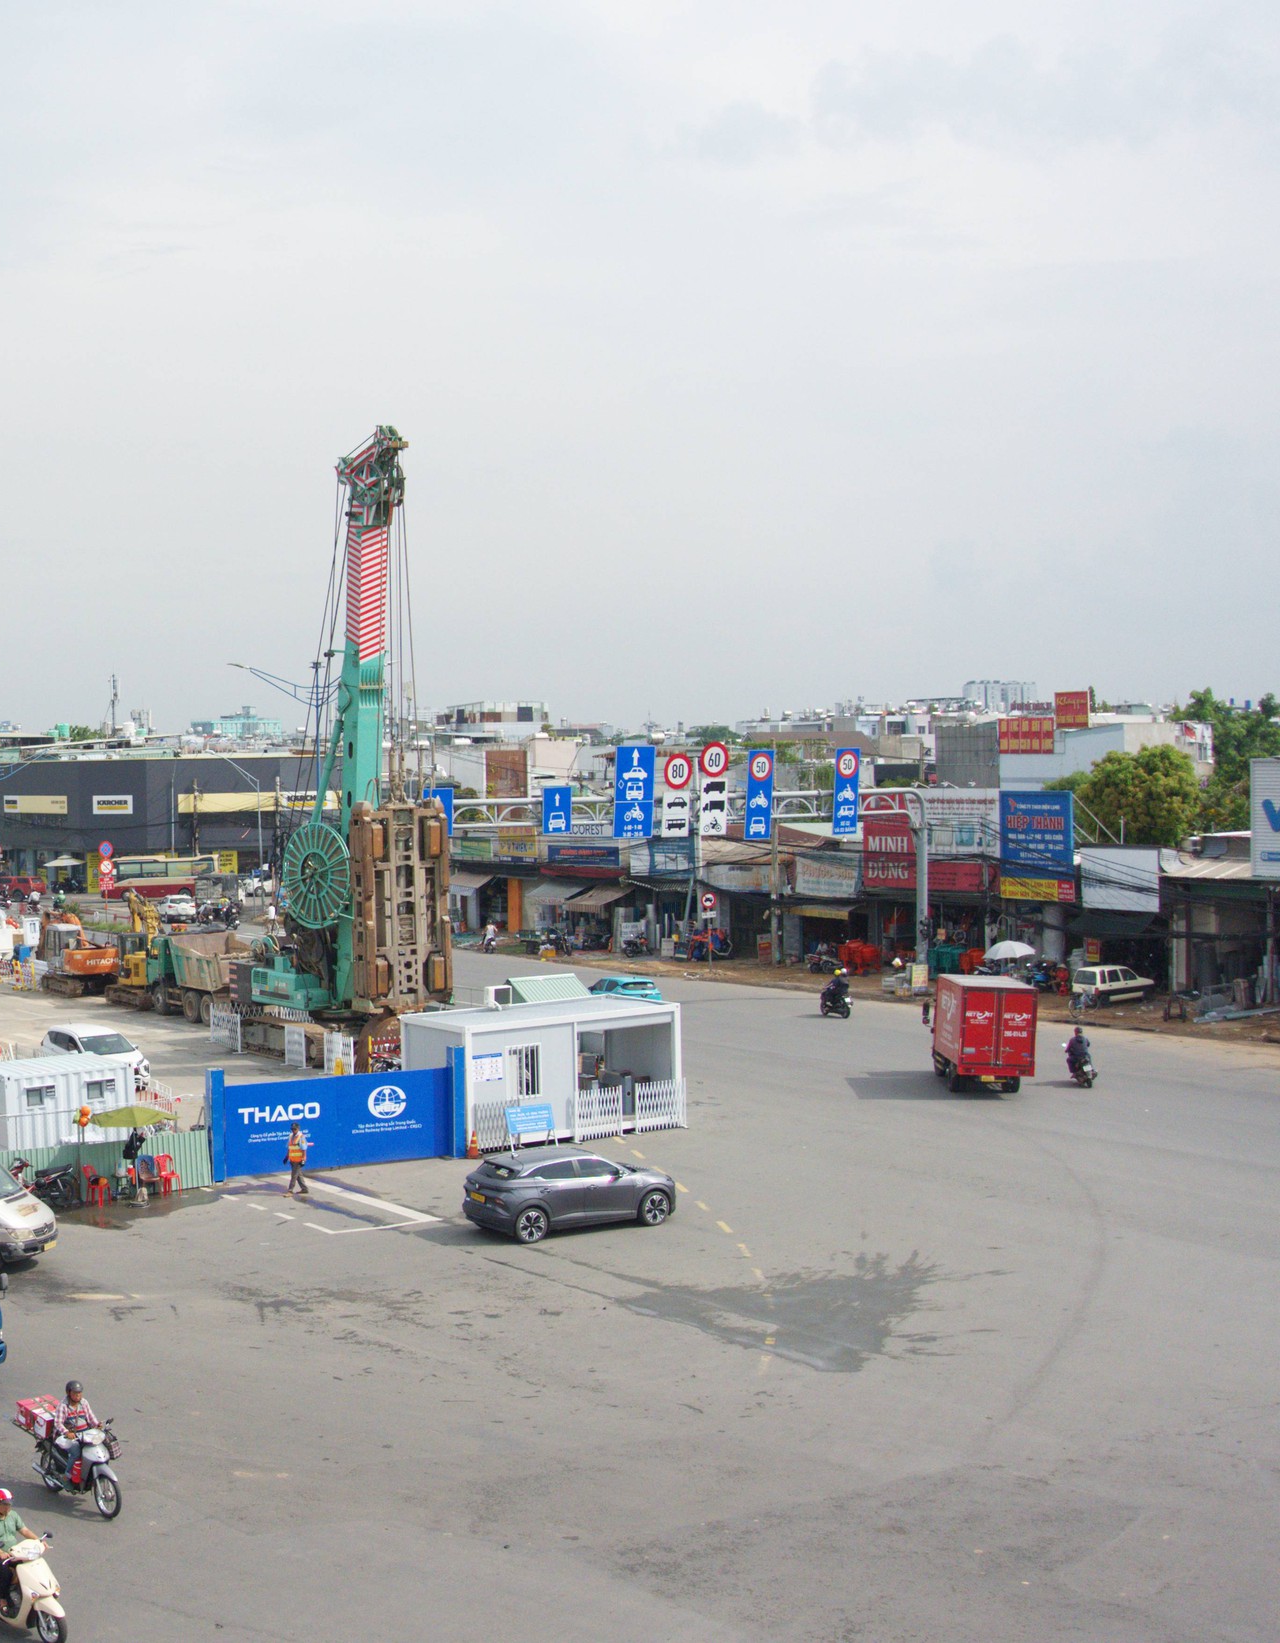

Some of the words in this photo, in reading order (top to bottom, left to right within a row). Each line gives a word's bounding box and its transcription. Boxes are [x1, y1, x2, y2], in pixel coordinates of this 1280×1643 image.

[708, 752, 720, 768] 60
[756, 762, 766, 773] 50
[843, 759, 852, 770] 50
[672, 764, 684, 778] 80
[561, 824, 604, 834] COREST
[1006, 812, 1029, 831] HIỆP
[1032, 812, 1064, 830] THÀNH
[868, 836, 908, 853] MINH
[868, 856, 908, 879] DŨNG
[238, 1102, 320, 1124] THACO
